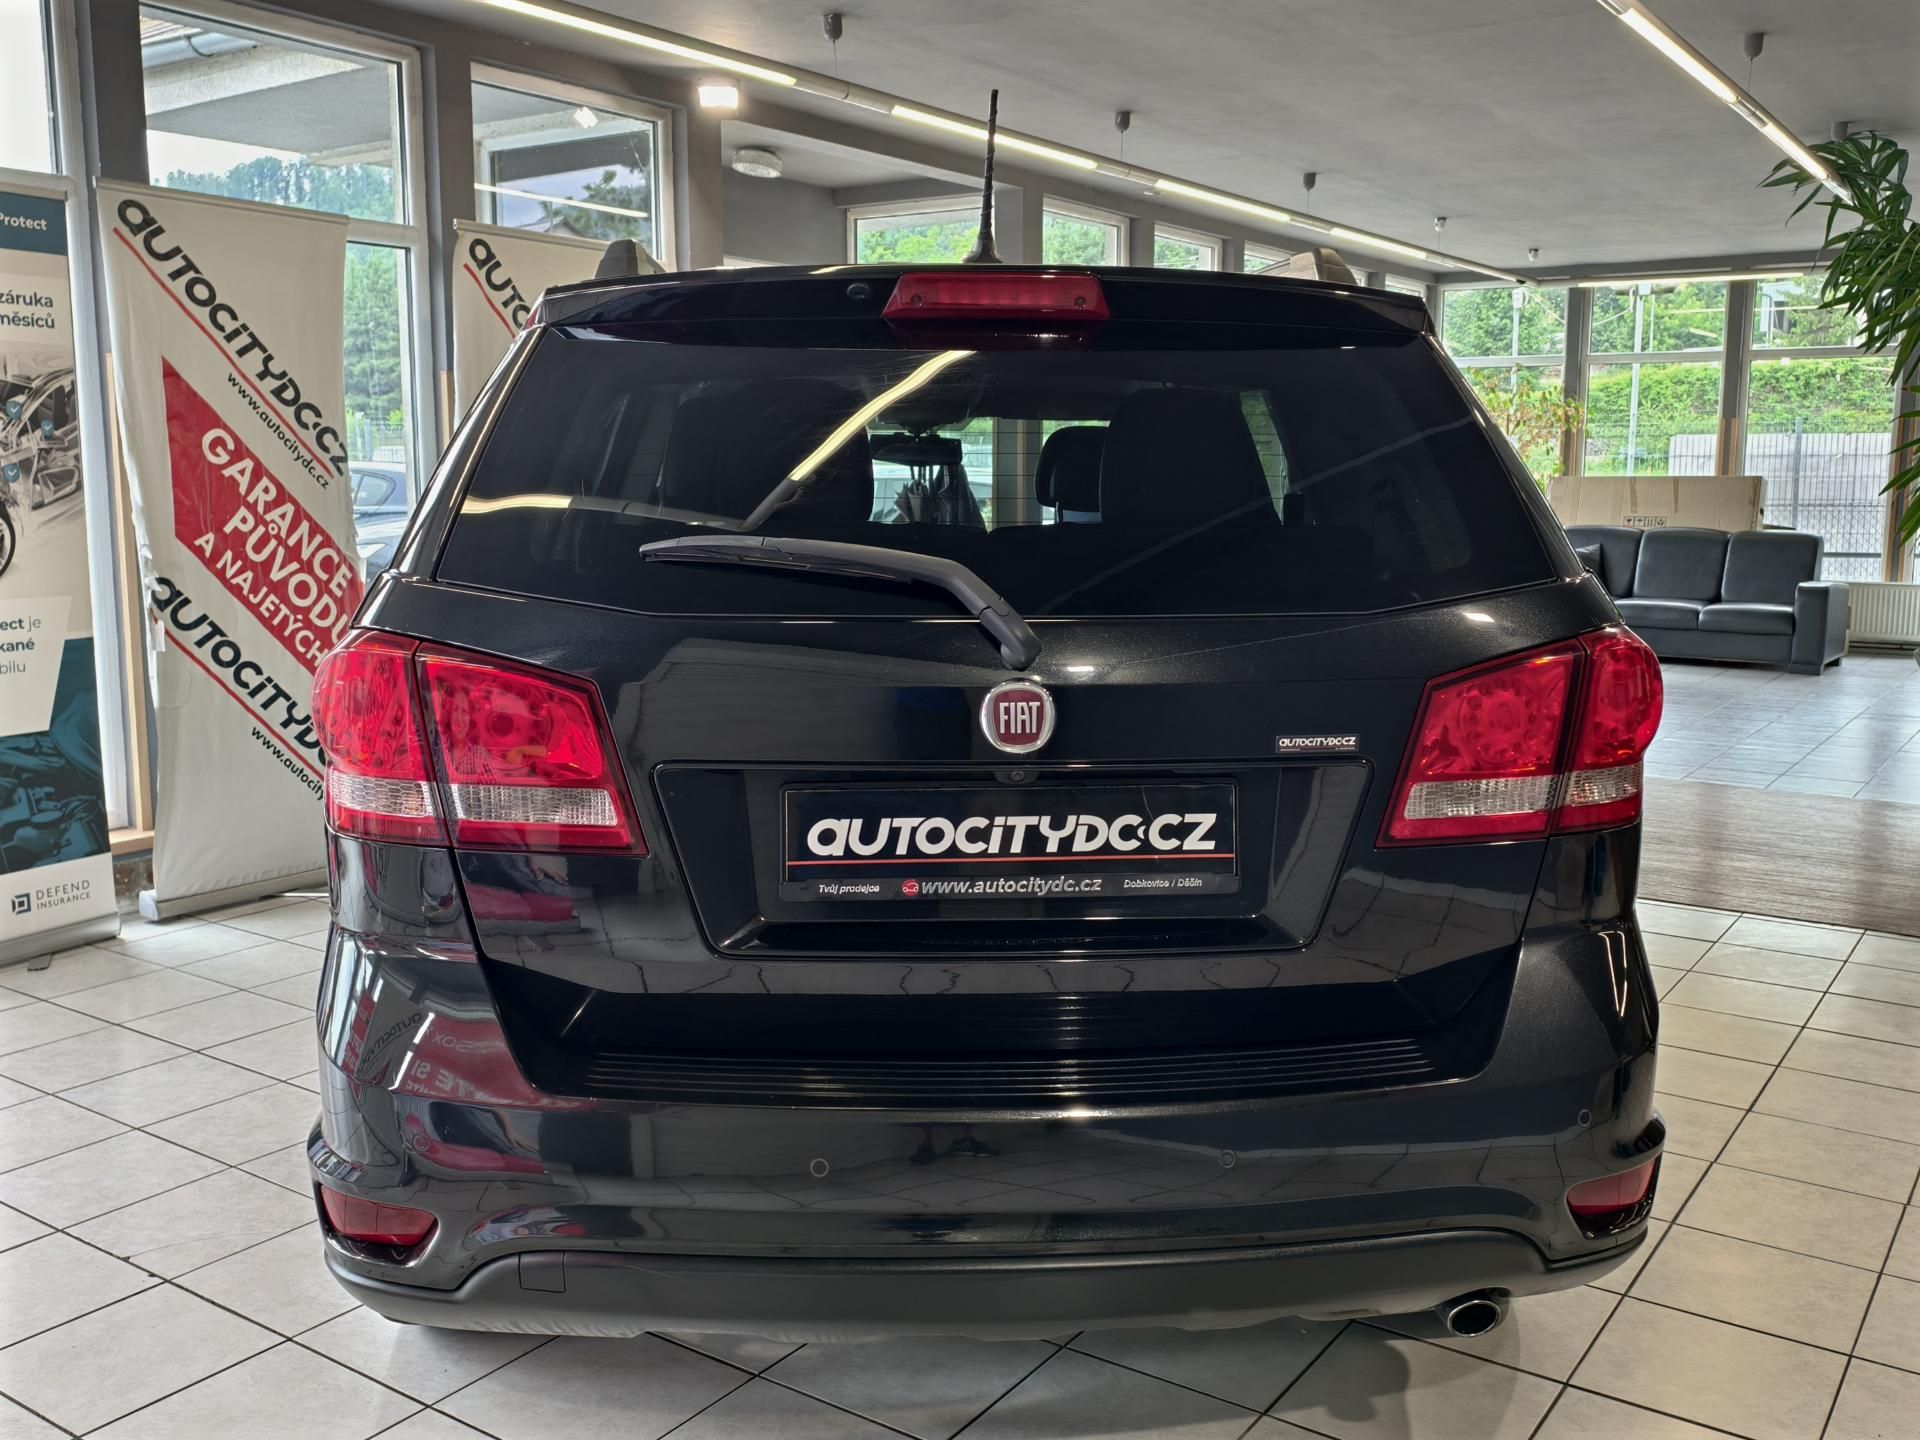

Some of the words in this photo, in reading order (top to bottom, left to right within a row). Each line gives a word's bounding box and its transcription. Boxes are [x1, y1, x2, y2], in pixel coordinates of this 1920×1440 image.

[0, 289, 54, 308] záruka
[0, 310, 55, 330] měsíců
[228, 373, 329, 489] www.autocitydc.cz
[201, 428, 353, 598] GARANCE
[194, 532, 215, 559] A
[216, 550, 330, 667] NAJETÝCH
[27, 616, 42, 633] je
[999, 701, 1041, 734] FIAT
[36, 879, 90, 901] DEFEND
[818, 883, 838, 894] Tvůj
[839, 883, 880, 895] prodejce
[921, 875, 1102, 896] www.autocitydc.cz
[1123, 879, 1170, 888] Dobkovice
[36, 891, 91, 911] INSURANCE
